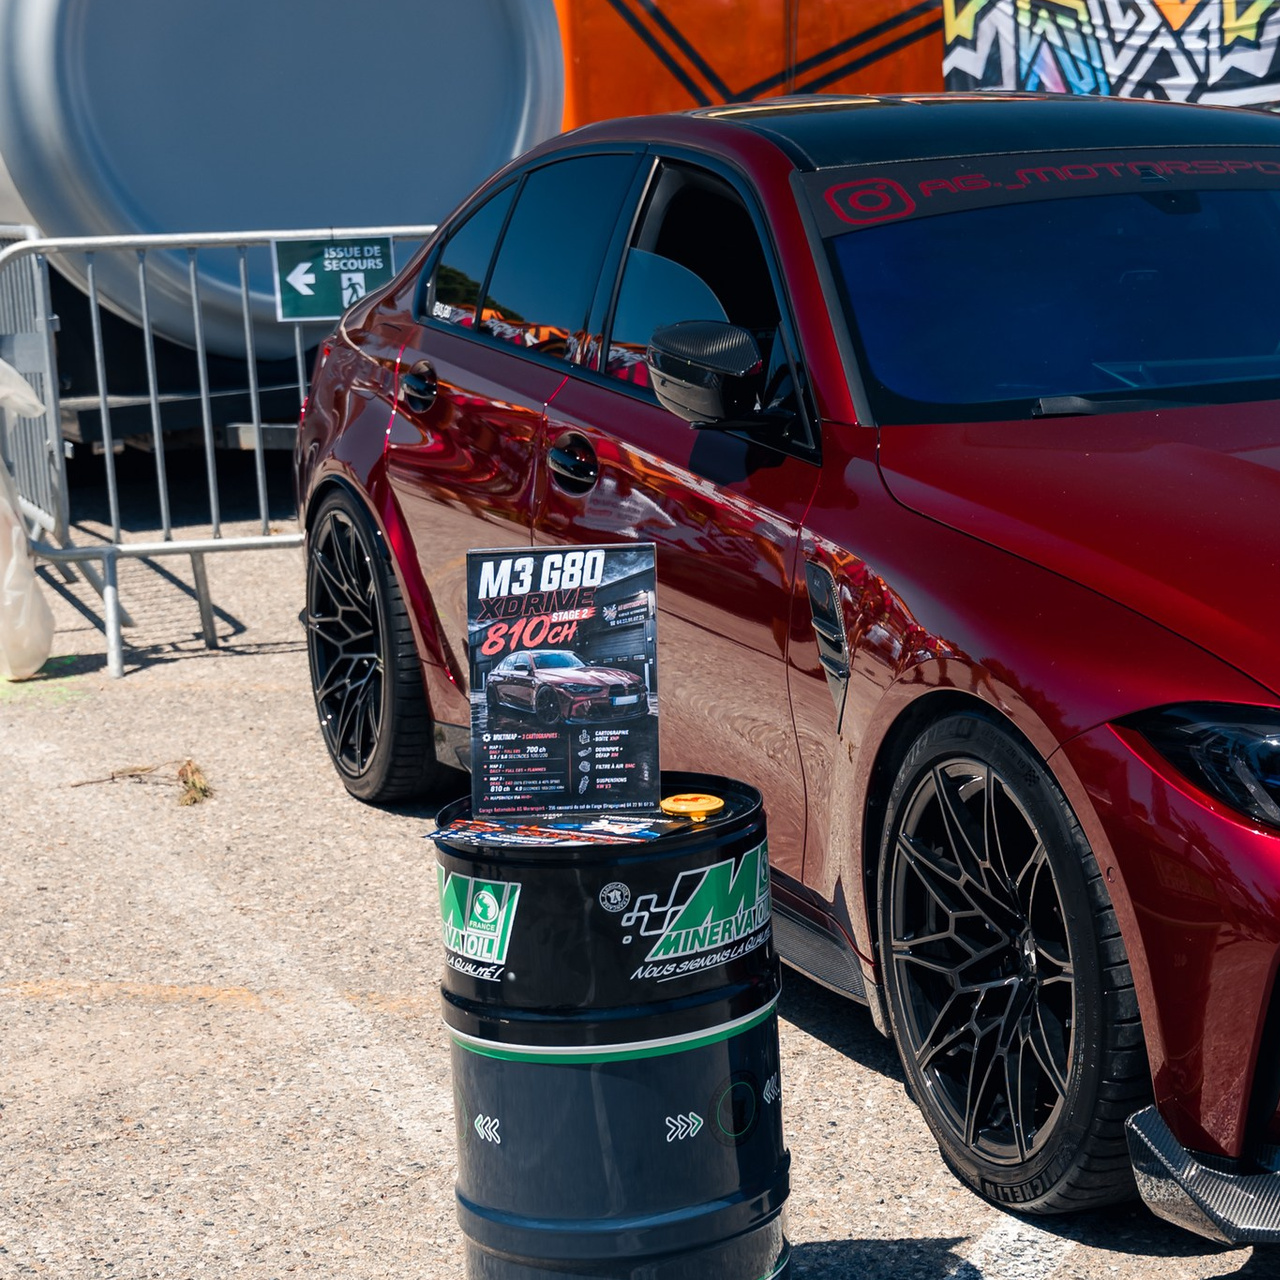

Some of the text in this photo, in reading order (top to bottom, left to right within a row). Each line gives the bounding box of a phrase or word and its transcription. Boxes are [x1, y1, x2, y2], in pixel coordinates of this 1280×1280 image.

[323, 245, 382, 259] ISSUE DE
[323, 258, 384, 272] SECOURS
[478, 549, 606, 600] M3 G80
[477, 586, 598, 622] XDRIVE
[551, 609, 589, 623] STAGE 2
[481, 614, 552, 657] 810
[526, 745, 539, 754] 700
[489, 785, 504, 793] 810
[468, 919, 497, 932] FRANCE
[646, 906, 757, 962] MINERVA
[466, 935, 495, 959] OIL
